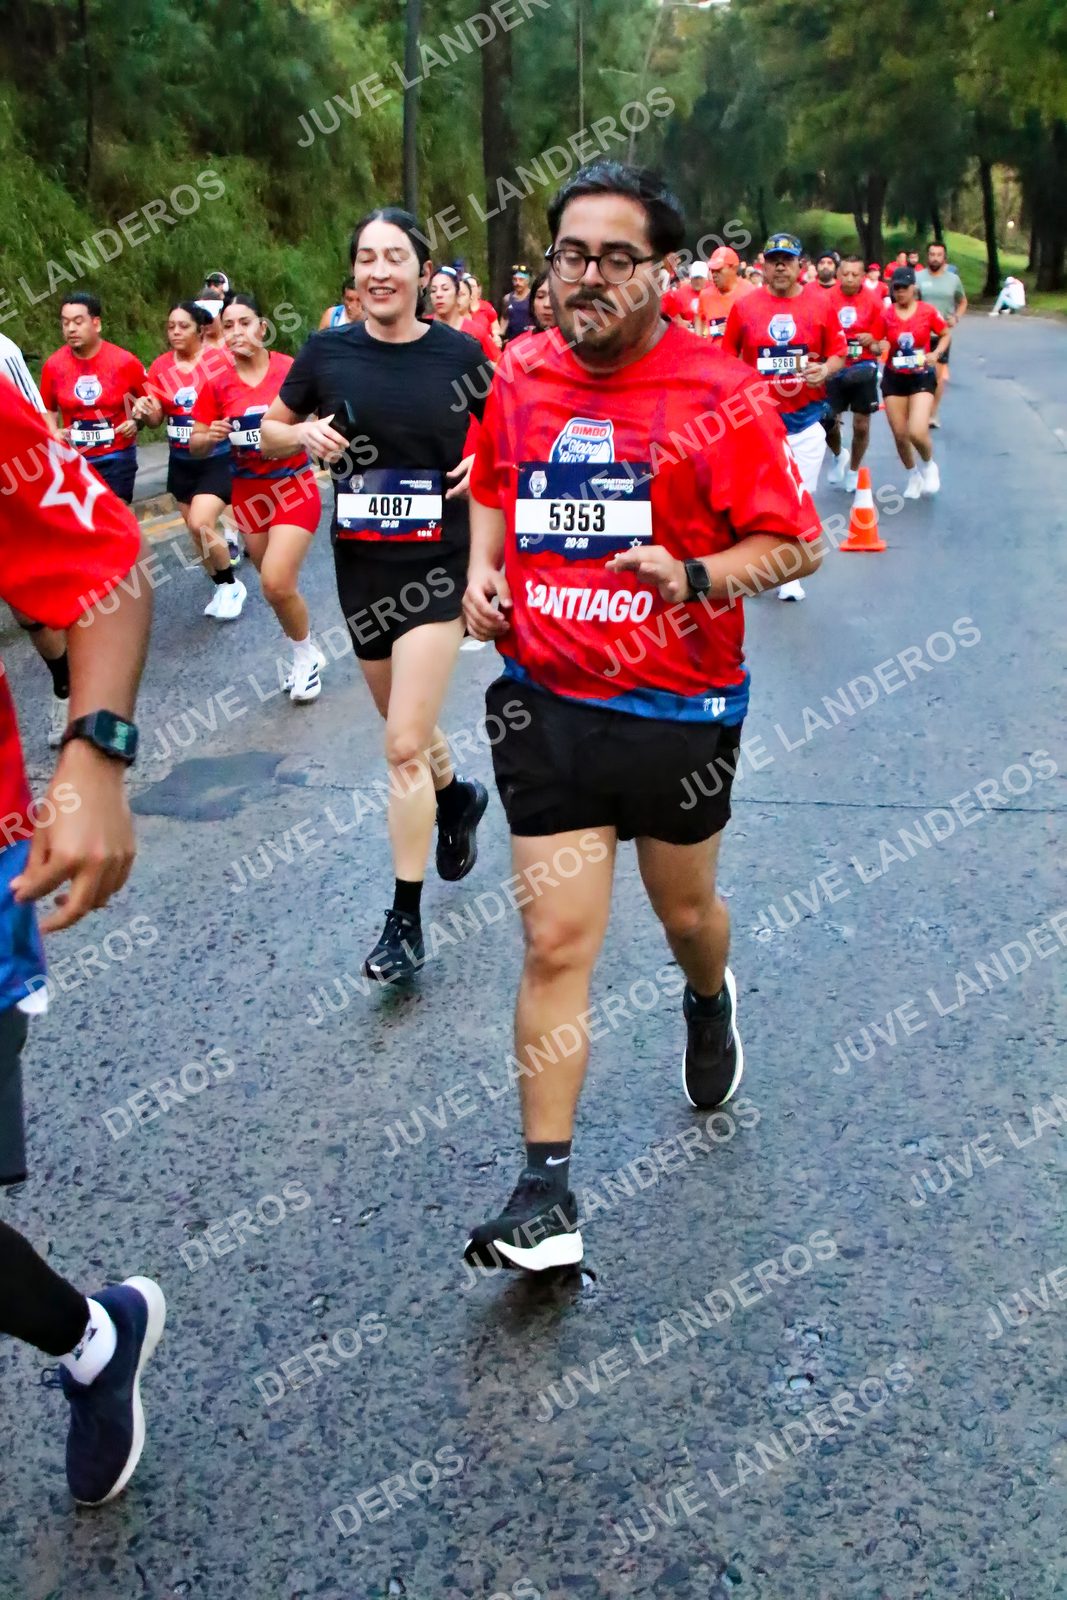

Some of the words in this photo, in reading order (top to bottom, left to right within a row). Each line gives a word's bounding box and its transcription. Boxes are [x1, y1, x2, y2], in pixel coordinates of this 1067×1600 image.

[246, 430, 261, 443] 45
[571, 425, 607, 437] BIMBO
[368, 496, 412, 517] 4087
[549, 503, 605, 532] 5353
